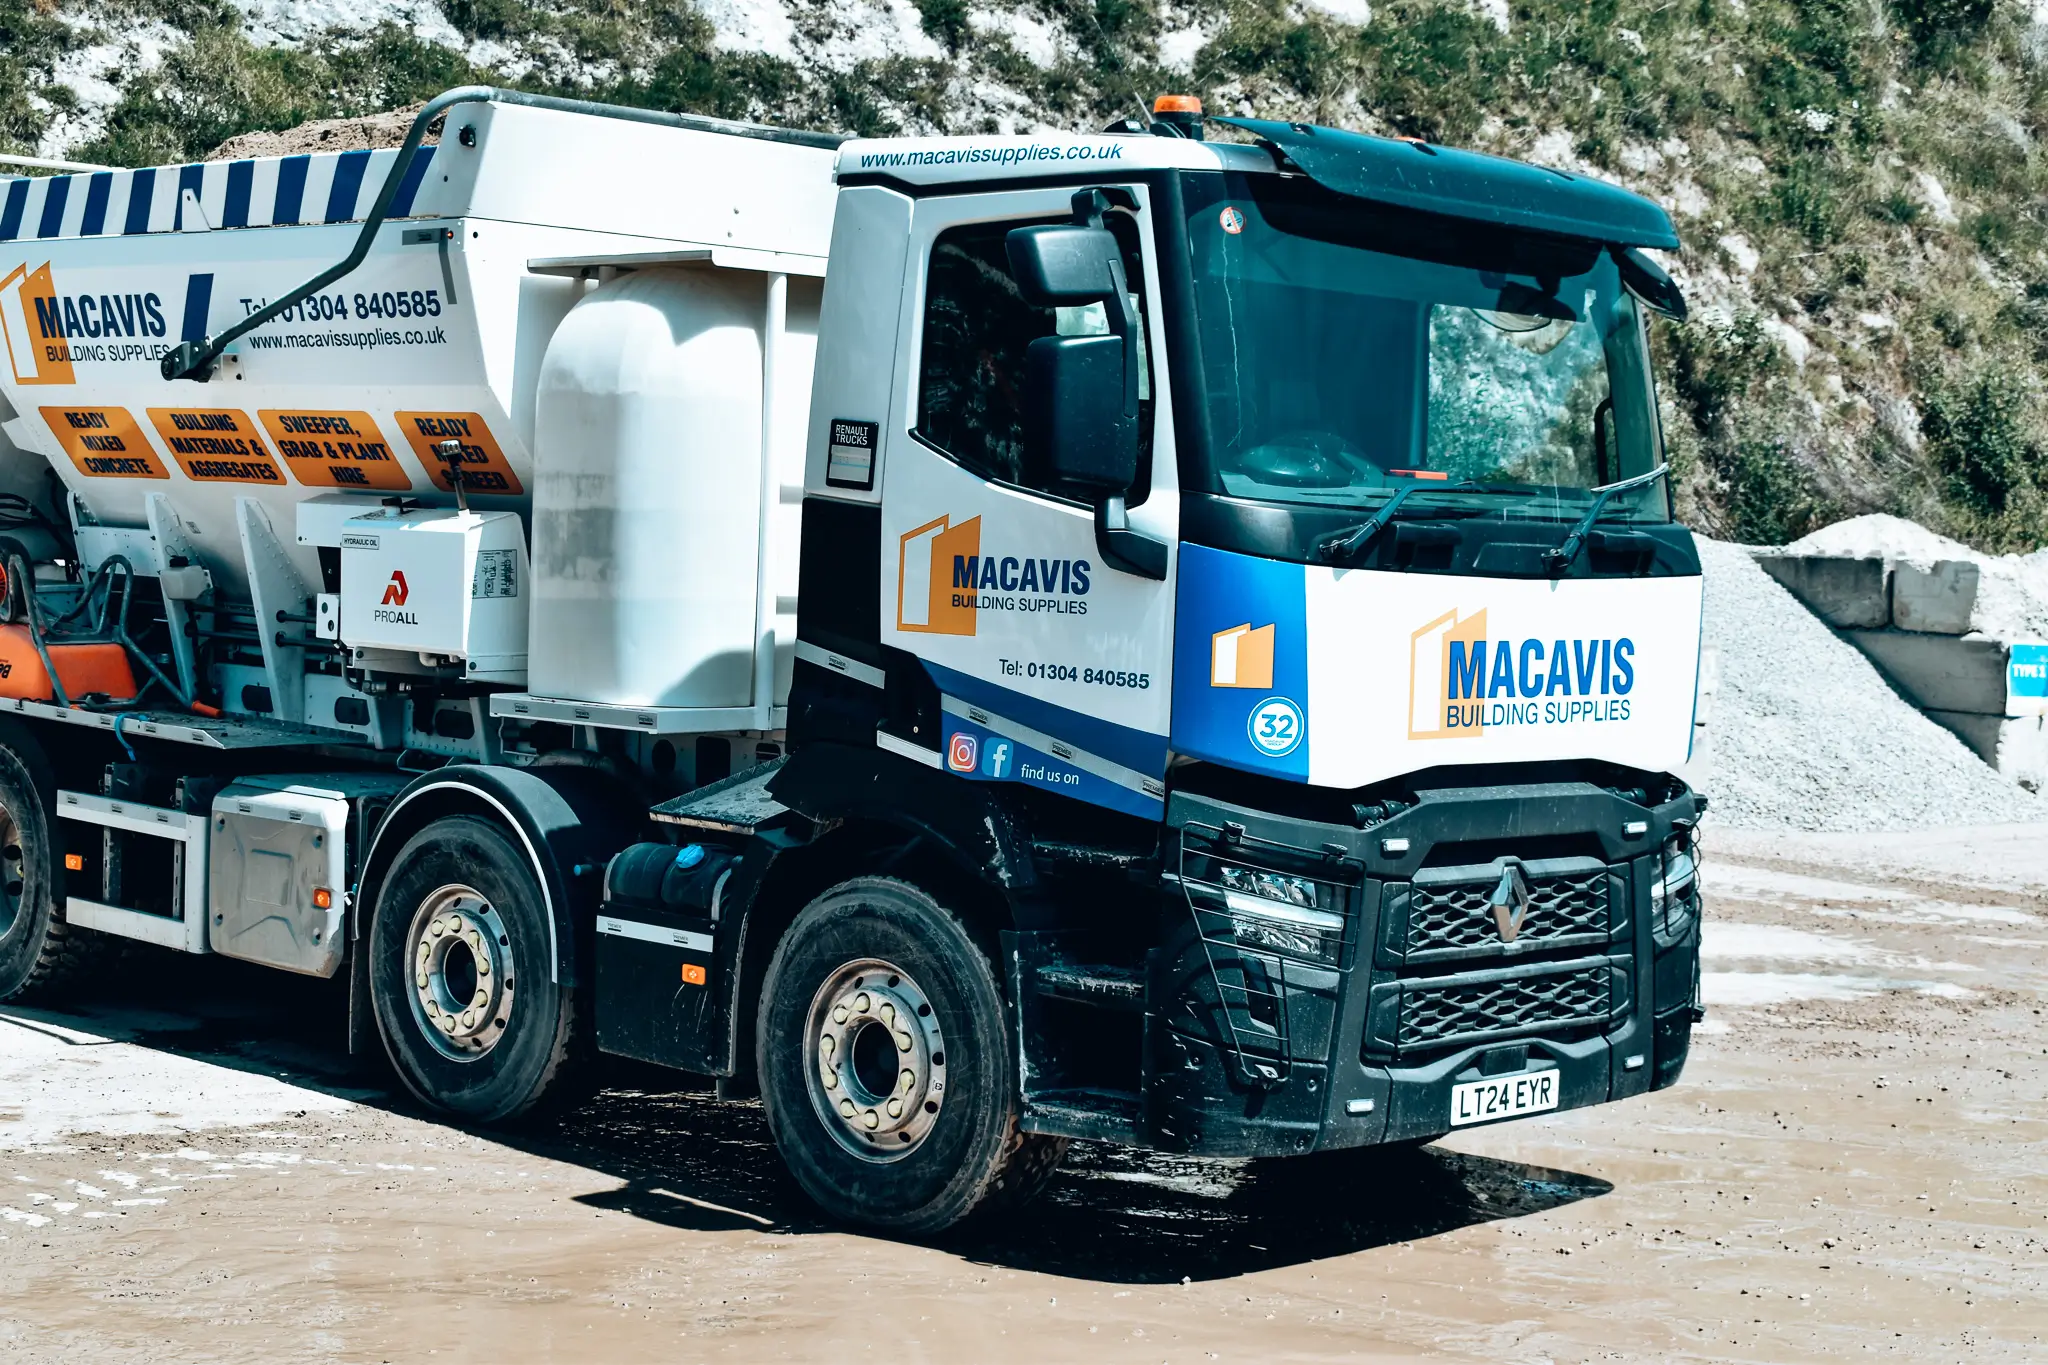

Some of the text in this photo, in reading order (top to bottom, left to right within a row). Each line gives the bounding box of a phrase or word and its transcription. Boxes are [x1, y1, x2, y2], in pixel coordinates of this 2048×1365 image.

[861, 143, 1124, 168] www.macavissupplies.co.uk
[354, 290, 441, 319] 840585
[34, 292, 166, 338] MACAVIS
[249, 326, 447, 350] www.macavissupplies.co.uk
[46, 345, 106, 362] BUILDING
[64, 412, 109, 429] READY
[170, 413, 239, 432] BUILDING
[279, 415, 362, 438] SWEEPER,
[414, 418, 472, 438] READY
[836, 424, 869, 436] RENAULT
[79, 435, 126, 451] MIXED
[169, 437, 266, 457] MATERIALS &
[836, 433, 867, 446] TRUCKS
[278, 440, 391, 461] GRAB & PLANT
[83, 457, 154, 474] CONCRETE
[188, 460, 278, 480] AGGREGATES
[329, 466, 371, 485] HIRE
[344, 537, 369, 545] HYDRAULIC
[953, 555, 1091, 595] MACAVIS
[952, 594, 1087, 615] BUILDING SUPPLIES
[374, 610, 418, 625] PROALL
[999, 658, 1150, 690] Tel: 01304 840585
[1448, 637, 1635, 699] MACAVIS
[2012, 664, 2038, 678] TYPE
[1446, 699, 1631, 728] BUILDING SUPPLIES
[1260, 714, 1293, 738] 32
[1021, 763, 1079, 785] find us on
[1460, 1076, 1551, 1118] LT24 EYR
